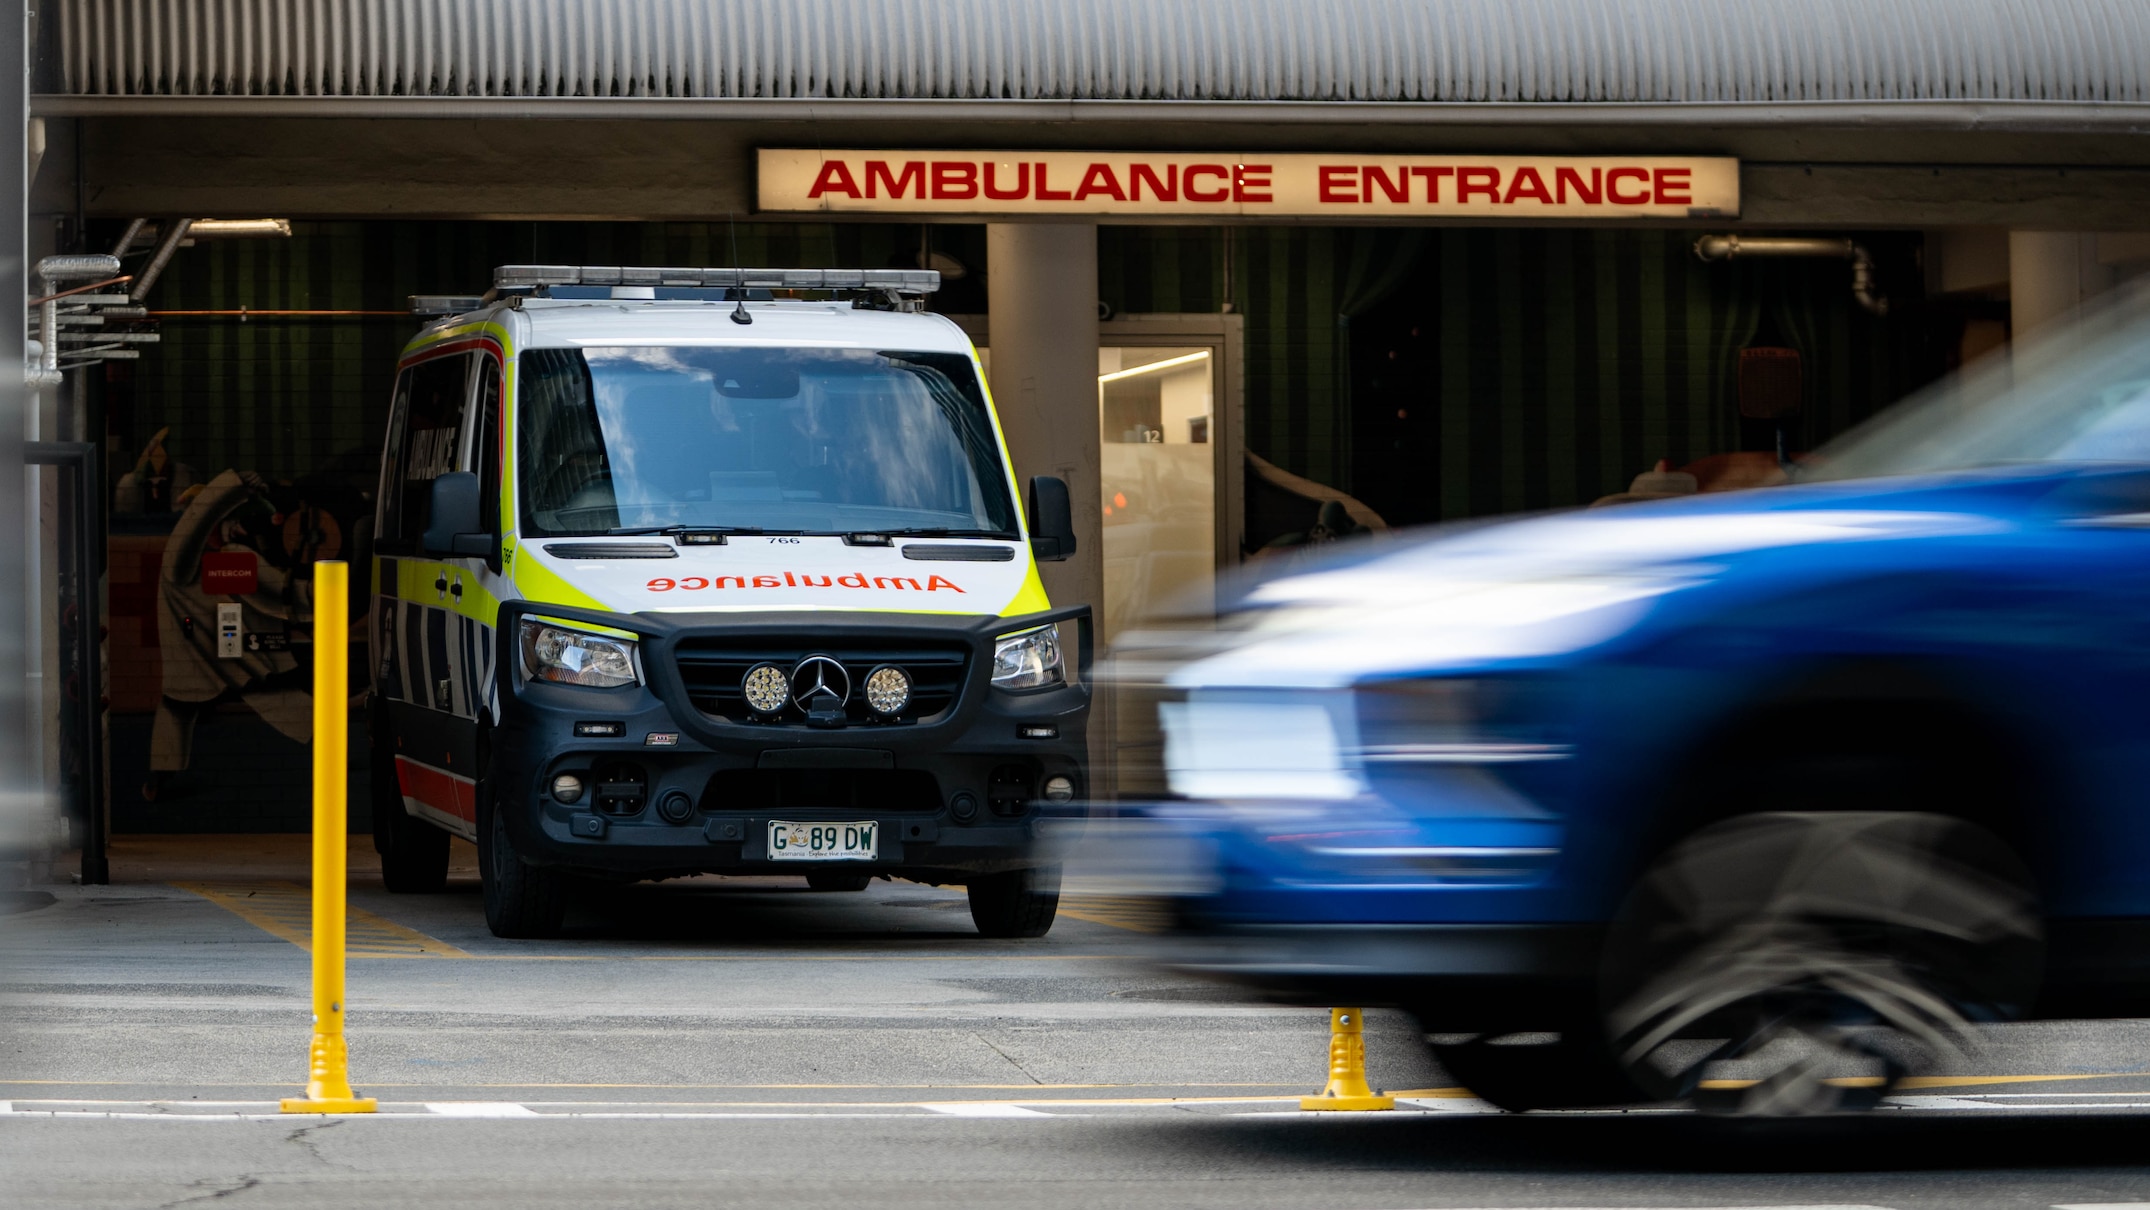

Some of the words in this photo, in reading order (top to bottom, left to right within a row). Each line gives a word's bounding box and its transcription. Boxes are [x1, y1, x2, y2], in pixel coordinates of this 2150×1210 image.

[807, 161, 1273, 202] AMBULANCE
[1318, 165, 1692, 206] ENTRANCE
[1143, 430, 1161, 443] 12
[766, 537, 800, 545] 766
[774, 826, 787, 850] G
[811, 827, 837, 851] 89
[845, 826, 873, 851] DW
